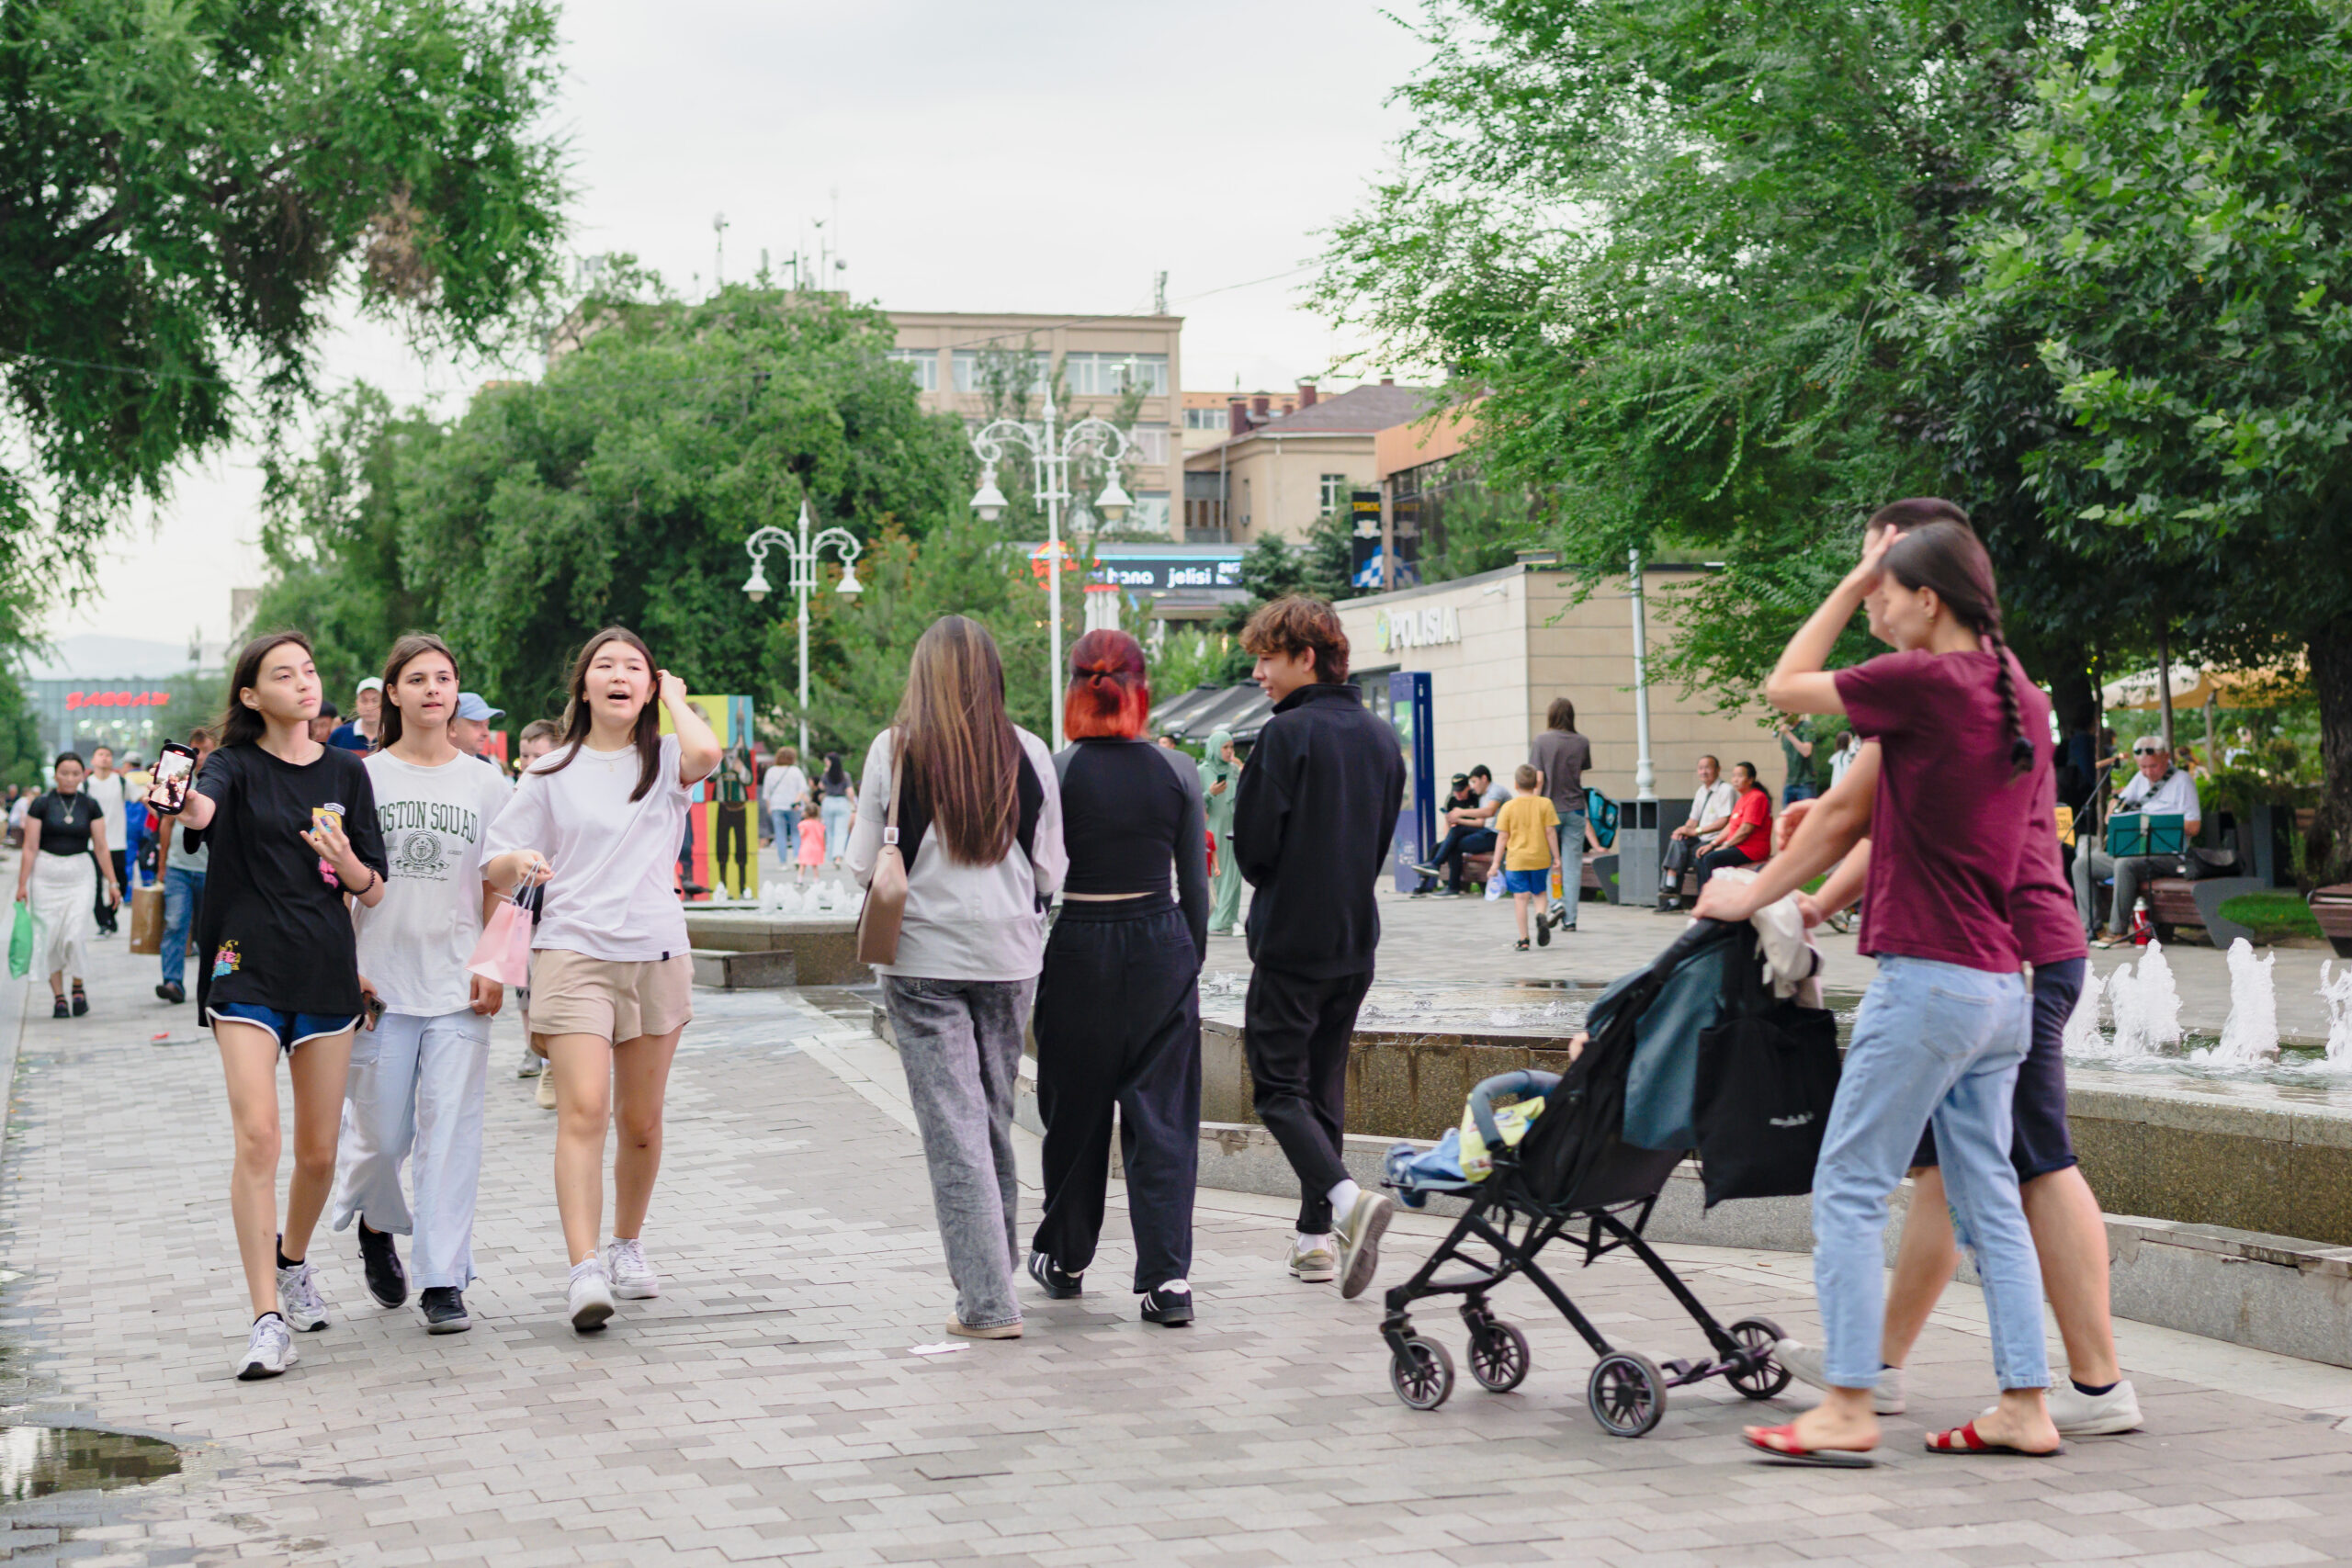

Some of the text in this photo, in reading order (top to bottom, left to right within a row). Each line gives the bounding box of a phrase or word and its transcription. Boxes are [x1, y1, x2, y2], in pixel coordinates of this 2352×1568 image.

[1167, 567, 1212, 588] jelisi
[1390, 607, 1461, 649] POLISIA
[376, 800, 478, 844] OSTON SQUAD
